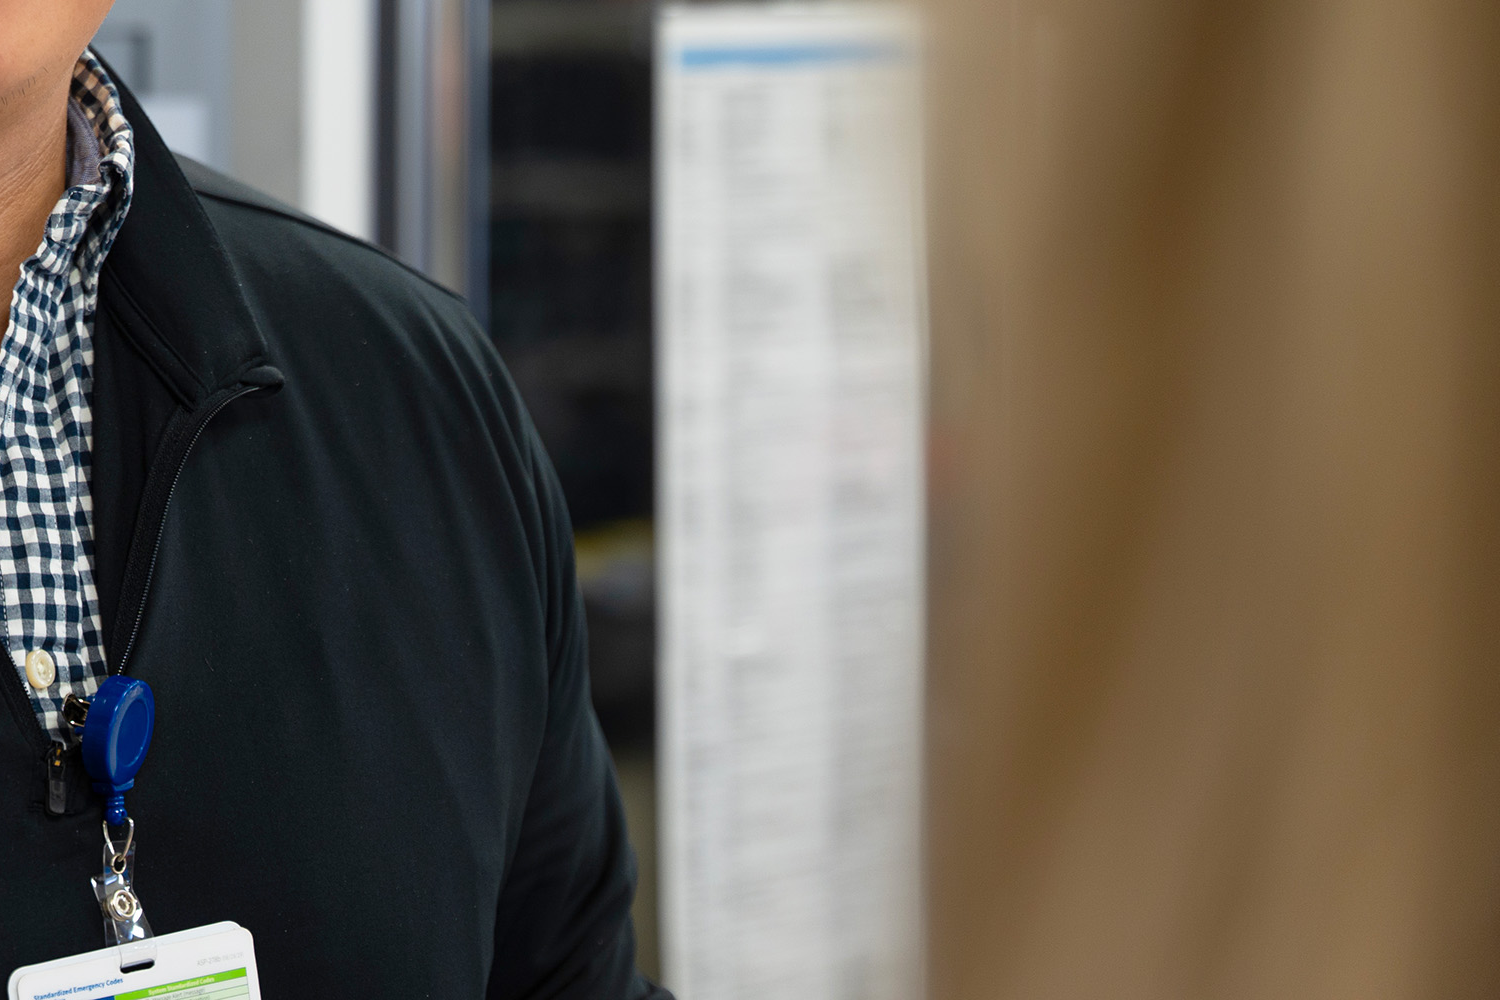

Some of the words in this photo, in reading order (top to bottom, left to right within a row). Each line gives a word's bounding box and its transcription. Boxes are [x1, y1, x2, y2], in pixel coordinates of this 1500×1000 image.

[33, 987, 73, 1000] Standardized
[73, 982, 105, 992] Emergency
[106, 977, 124, 986] Codes
